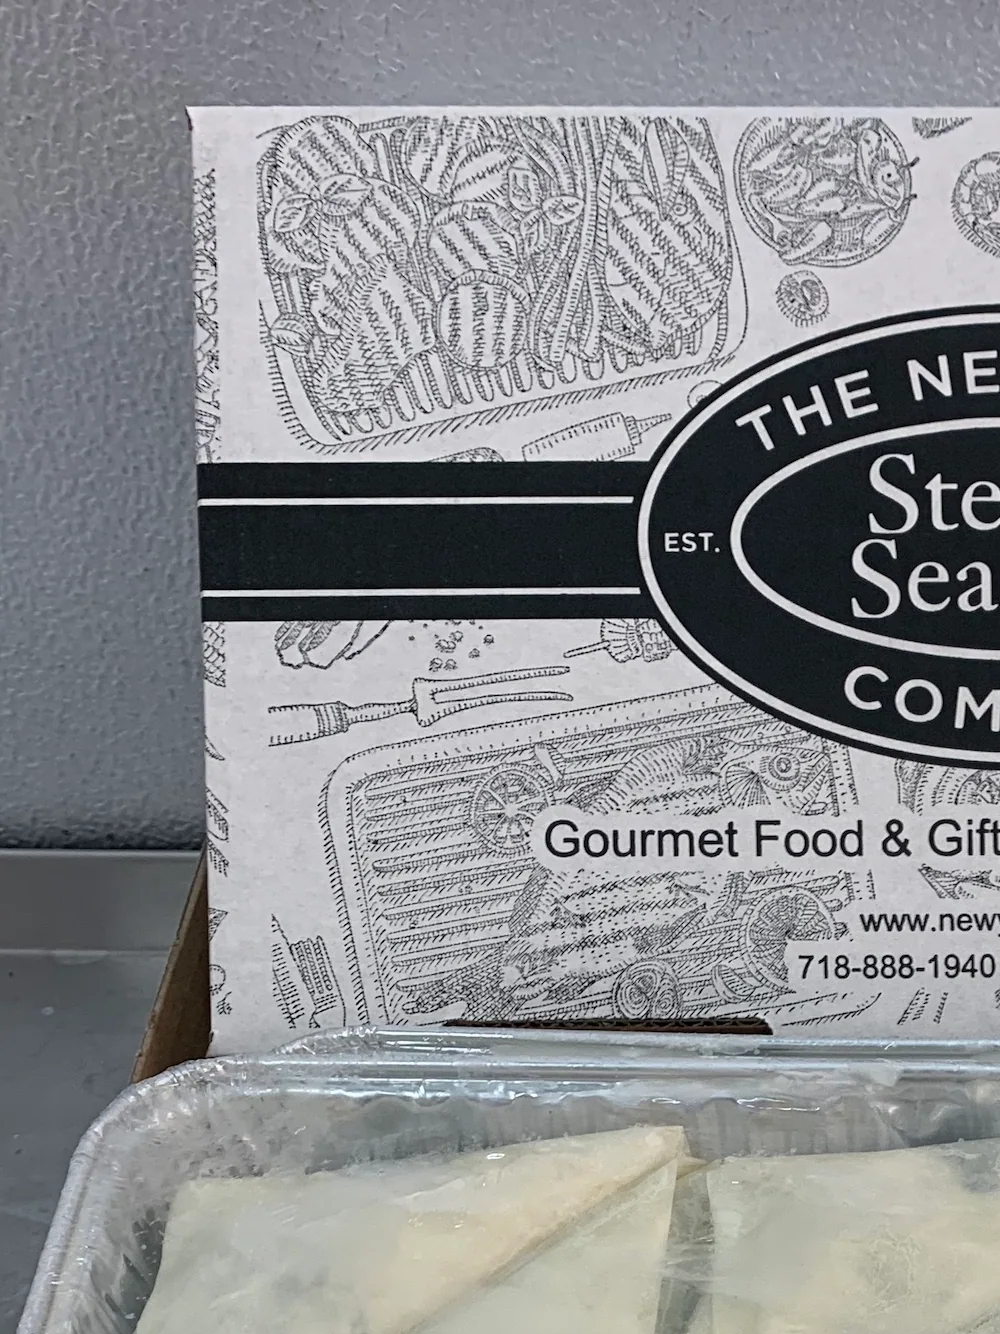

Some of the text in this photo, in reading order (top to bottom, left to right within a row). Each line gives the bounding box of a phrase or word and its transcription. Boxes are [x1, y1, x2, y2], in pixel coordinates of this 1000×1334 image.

[736, 371, 879, 452] THE
[664, 532, 720, 553] EST.
[544, 819, 739, 858] Gourmet
[755, 818, 864, 858] Food
[881, 818, 912, 858] &
[798, 953, 996, 980] 718-888-1940
